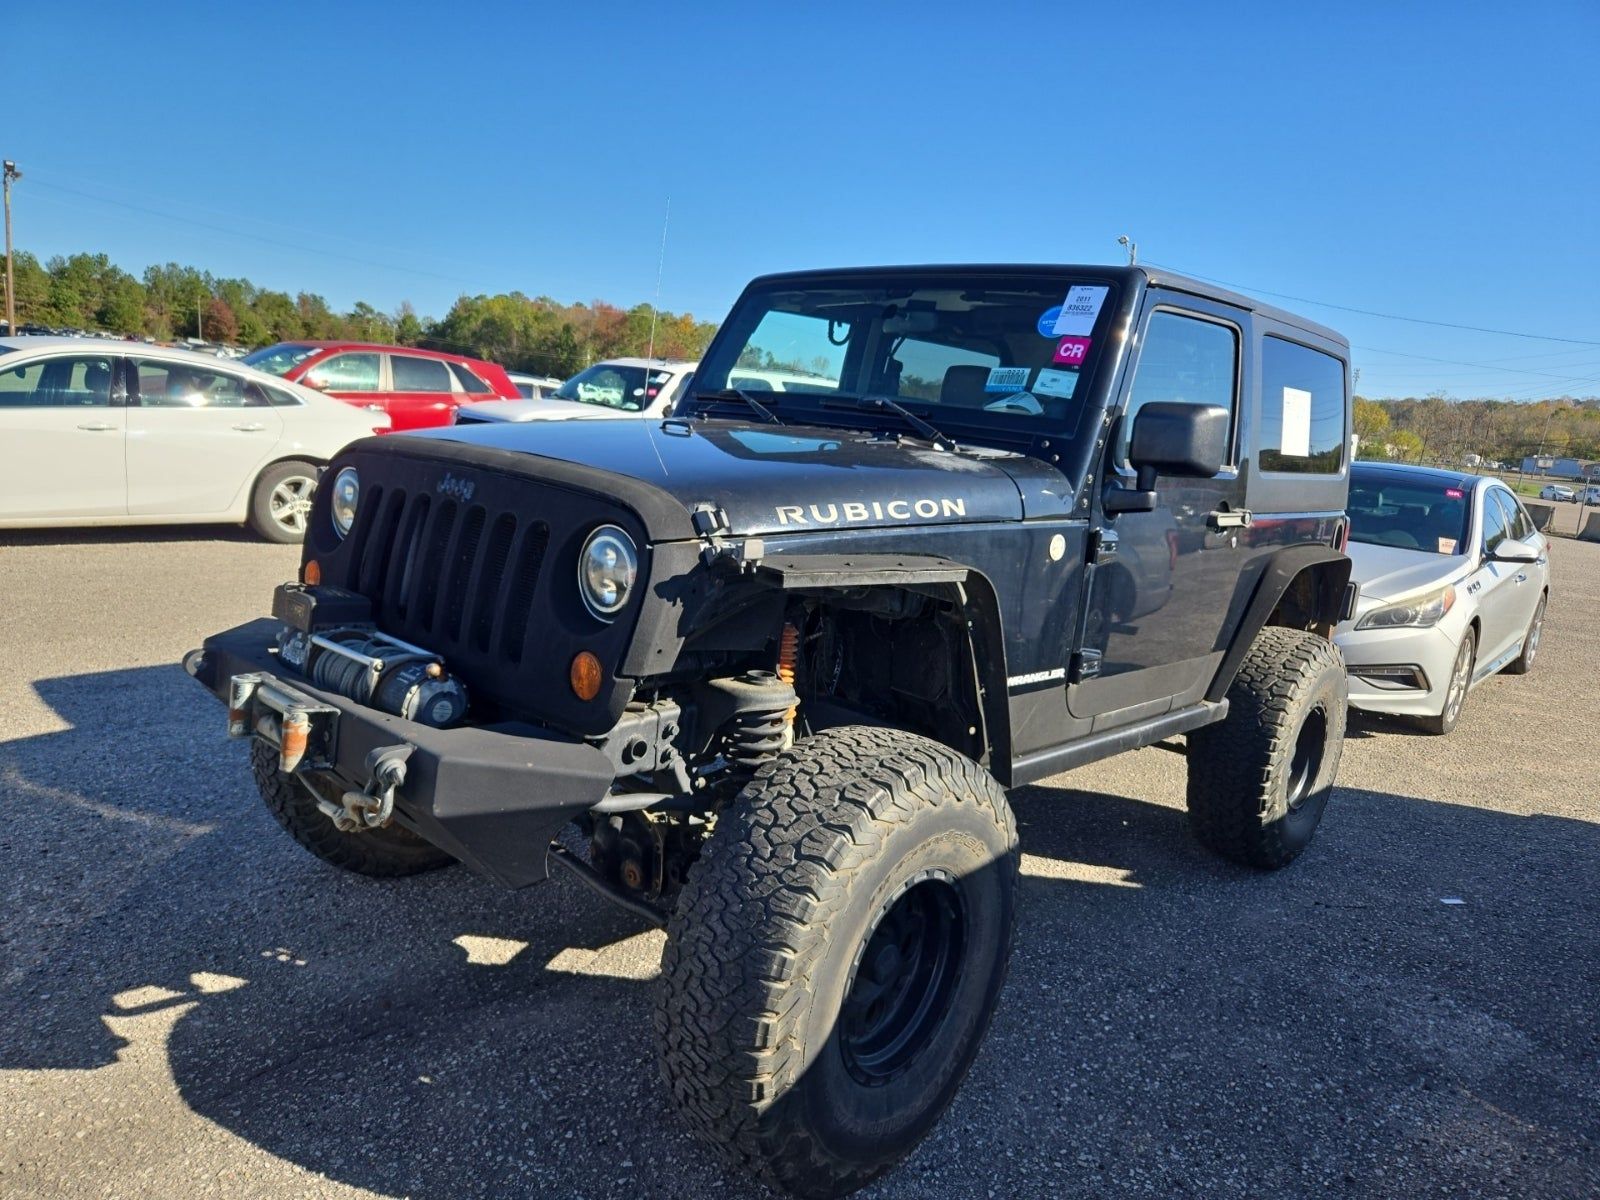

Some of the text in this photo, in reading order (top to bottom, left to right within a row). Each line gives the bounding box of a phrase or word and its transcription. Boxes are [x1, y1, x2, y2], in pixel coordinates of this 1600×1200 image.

[1059, 343, 1085, 358] CR
[436, 473, 475, 502] Jeep
[775, 498, 966, 525] RUBICON
[1007, 667, 1065, 688] WRANGLER
